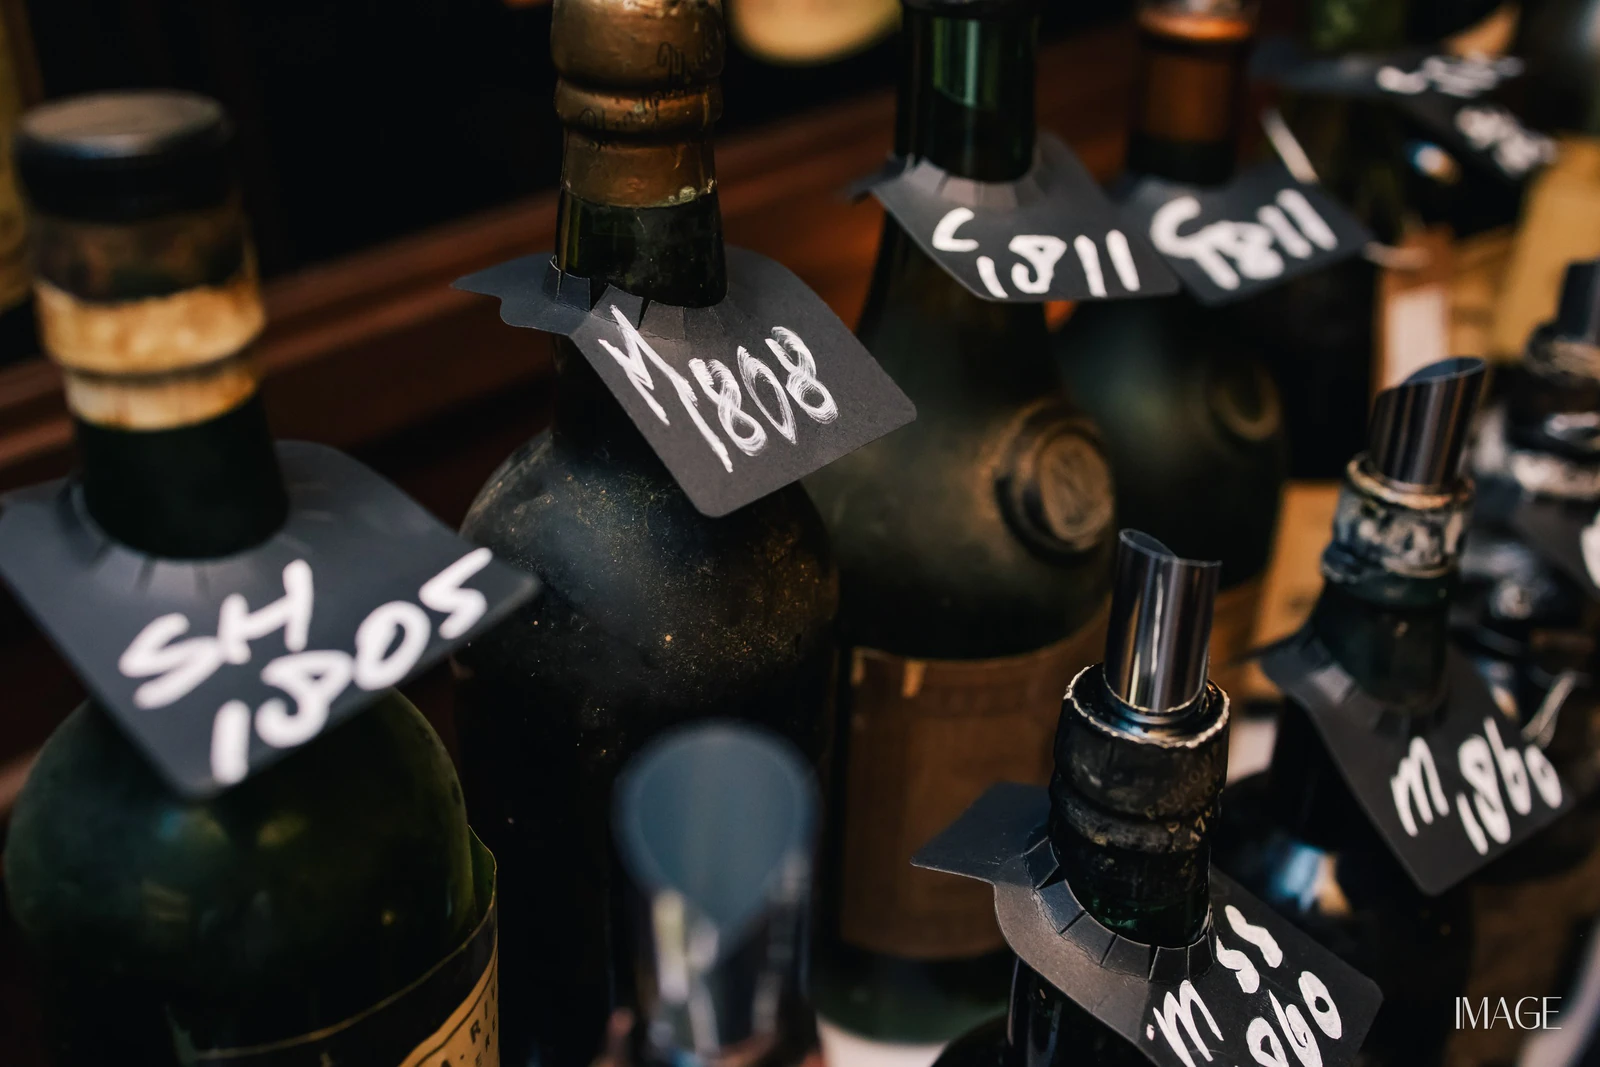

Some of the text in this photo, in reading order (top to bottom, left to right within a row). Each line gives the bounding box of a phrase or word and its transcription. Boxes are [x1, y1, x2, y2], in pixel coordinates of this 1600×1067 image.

[976, 229, 1140, 298] 1811
[672, 325, 840, 474] 1808
[118, 557, 314, 710] SH
[210, 546, 494, 785] 1805
[1455, 715, 1563, 856] 1860
[1233, 970, 1343, 1067] 860
